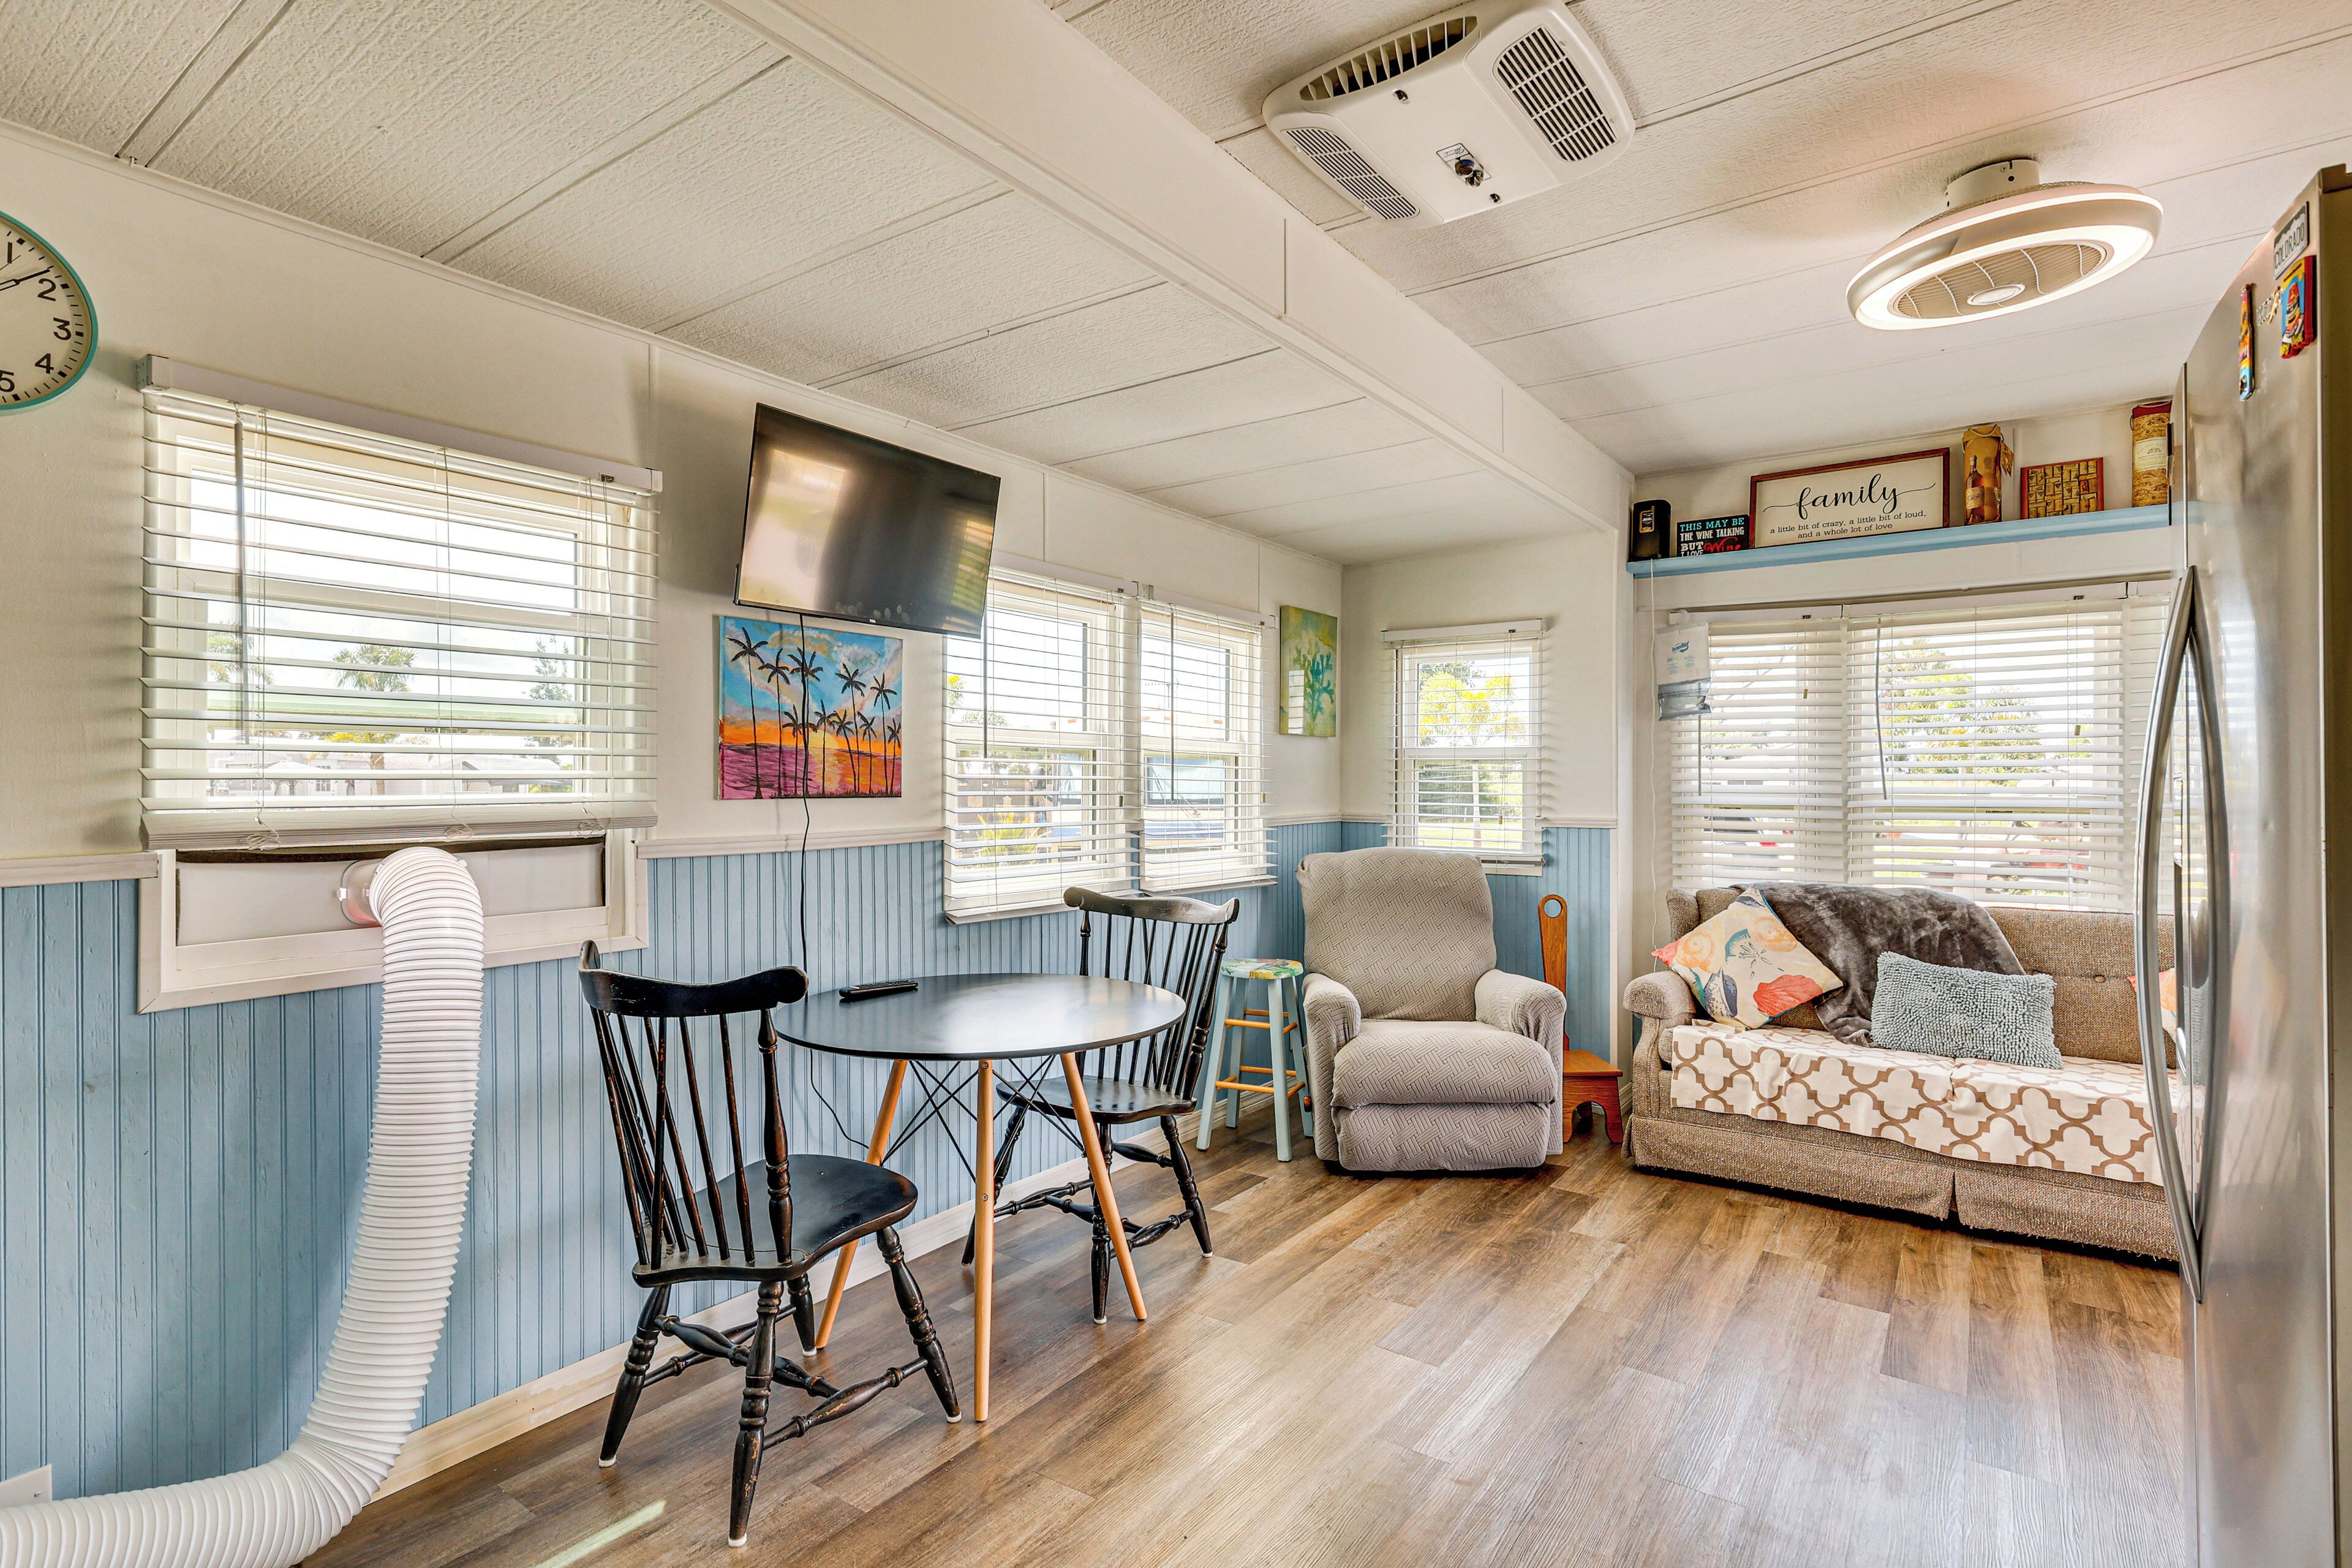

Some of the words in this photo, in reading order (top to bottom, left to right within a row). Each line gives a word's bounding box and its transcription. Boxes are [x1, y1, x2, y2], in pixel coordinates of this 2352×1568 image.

[2274, 222, 2304, 269] COLORADO
[37, 277, 56, 302] 2
[53, 317, 72, 341] 3
[34, 353, 55, 375] 4
[0, 369, 15, 393] 5
[1763, 473, 1936, 519] family
[1679, 522, 1702, 532] THIS
[1706, 519, 1728, 529] MAY
[1732, 518, 1744, 526] BE
[1679, 532, 1694, 541] THE
[1695, 530, 1714, 539] WINE
[1716, 527, 1744, 538] TALKING
[1681, 541, 1703, 551] BUT
[1703, 536, 1741, 552] Wine
